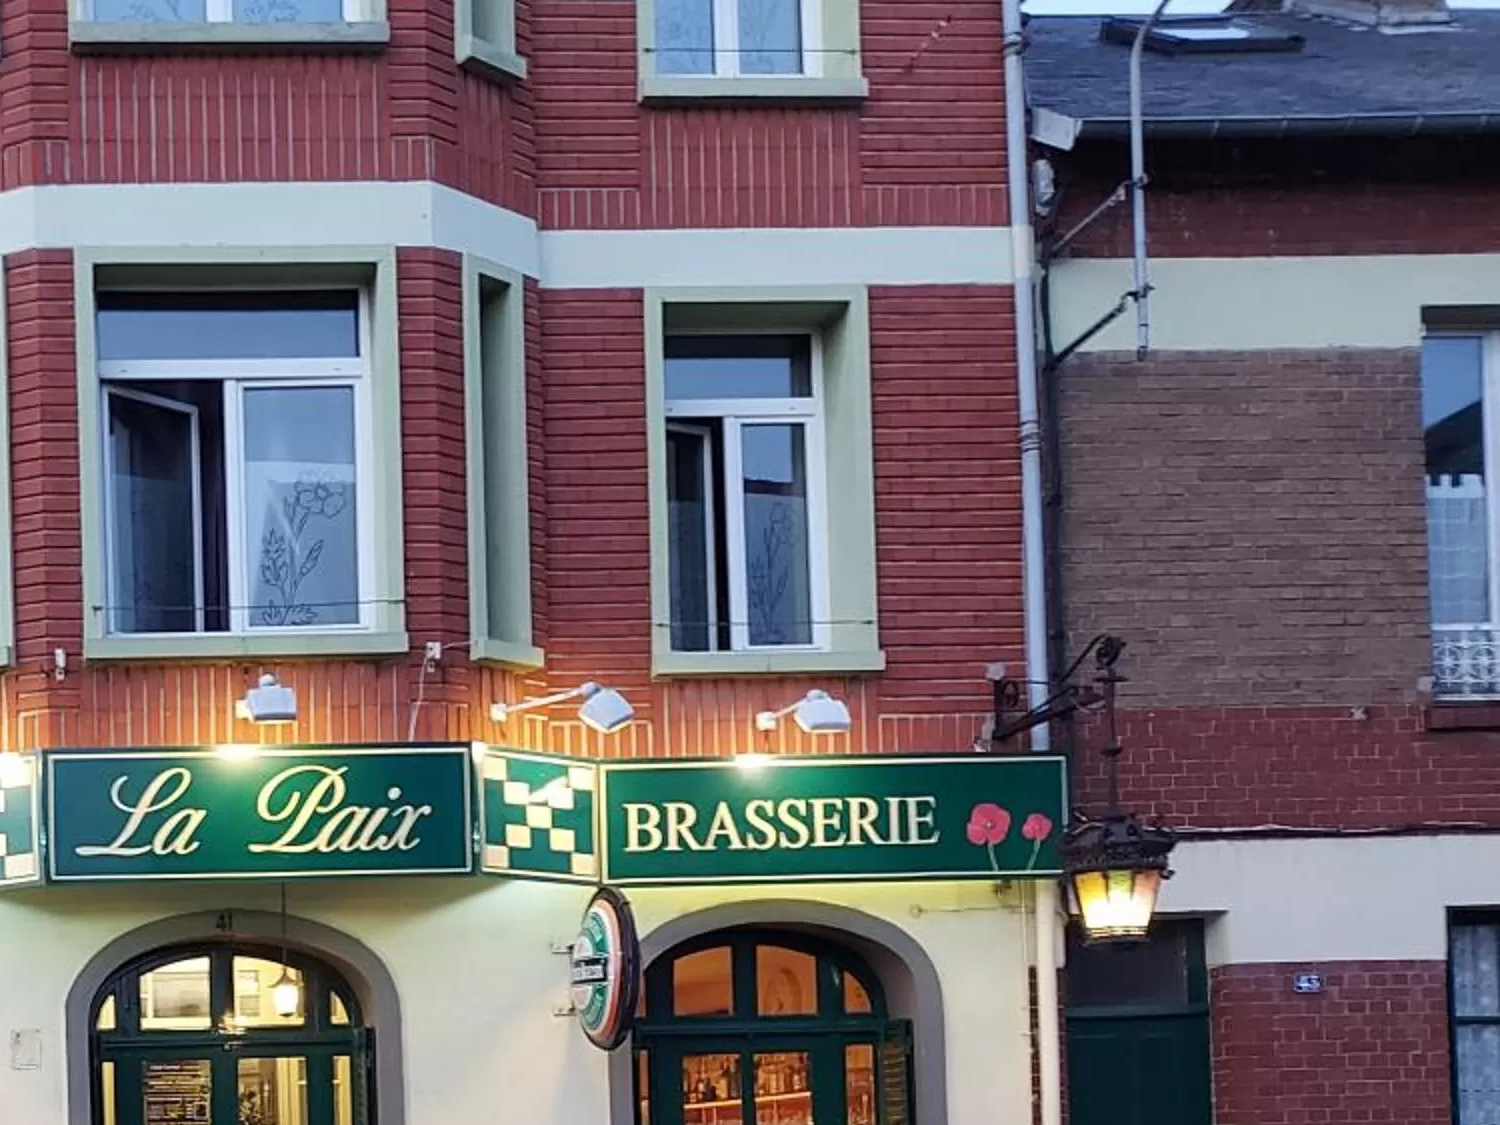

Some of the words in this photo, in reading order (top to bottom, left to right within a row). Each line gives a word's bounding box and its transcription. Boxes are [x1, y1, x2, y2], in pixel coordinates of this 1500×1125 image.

[75, 766, 208, 857] La
[247, 765, 432, 854] Paix
[623, 796, 941, 853] BRASSERIE
